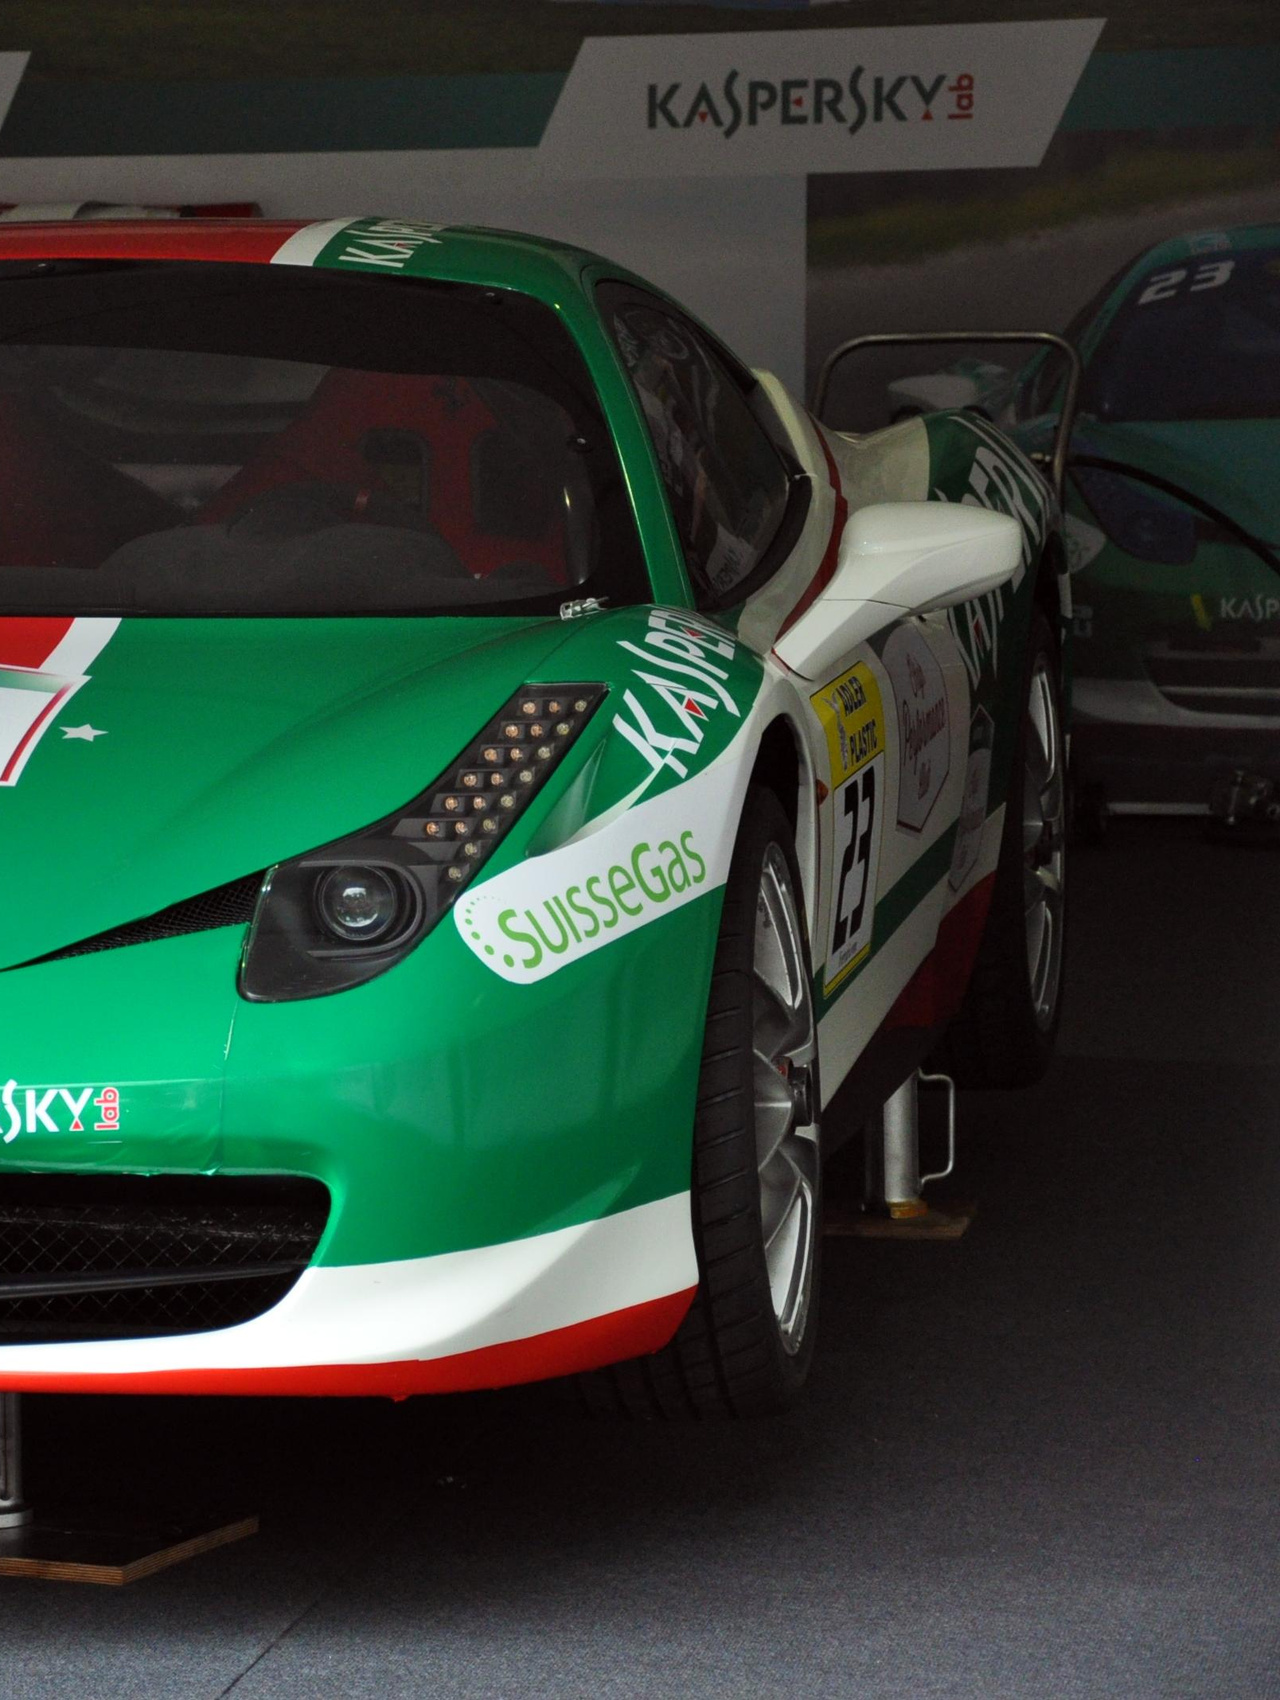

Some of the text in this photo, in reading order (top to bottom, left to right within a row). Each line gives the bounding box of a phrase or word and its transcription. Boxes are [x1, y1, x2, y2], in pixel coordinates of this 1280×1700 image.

[647, 65, 974, 139] KASPERSKY lab
[1138, 259, 1236, 305] 23
[94, 1086, 120, 1131] lab
